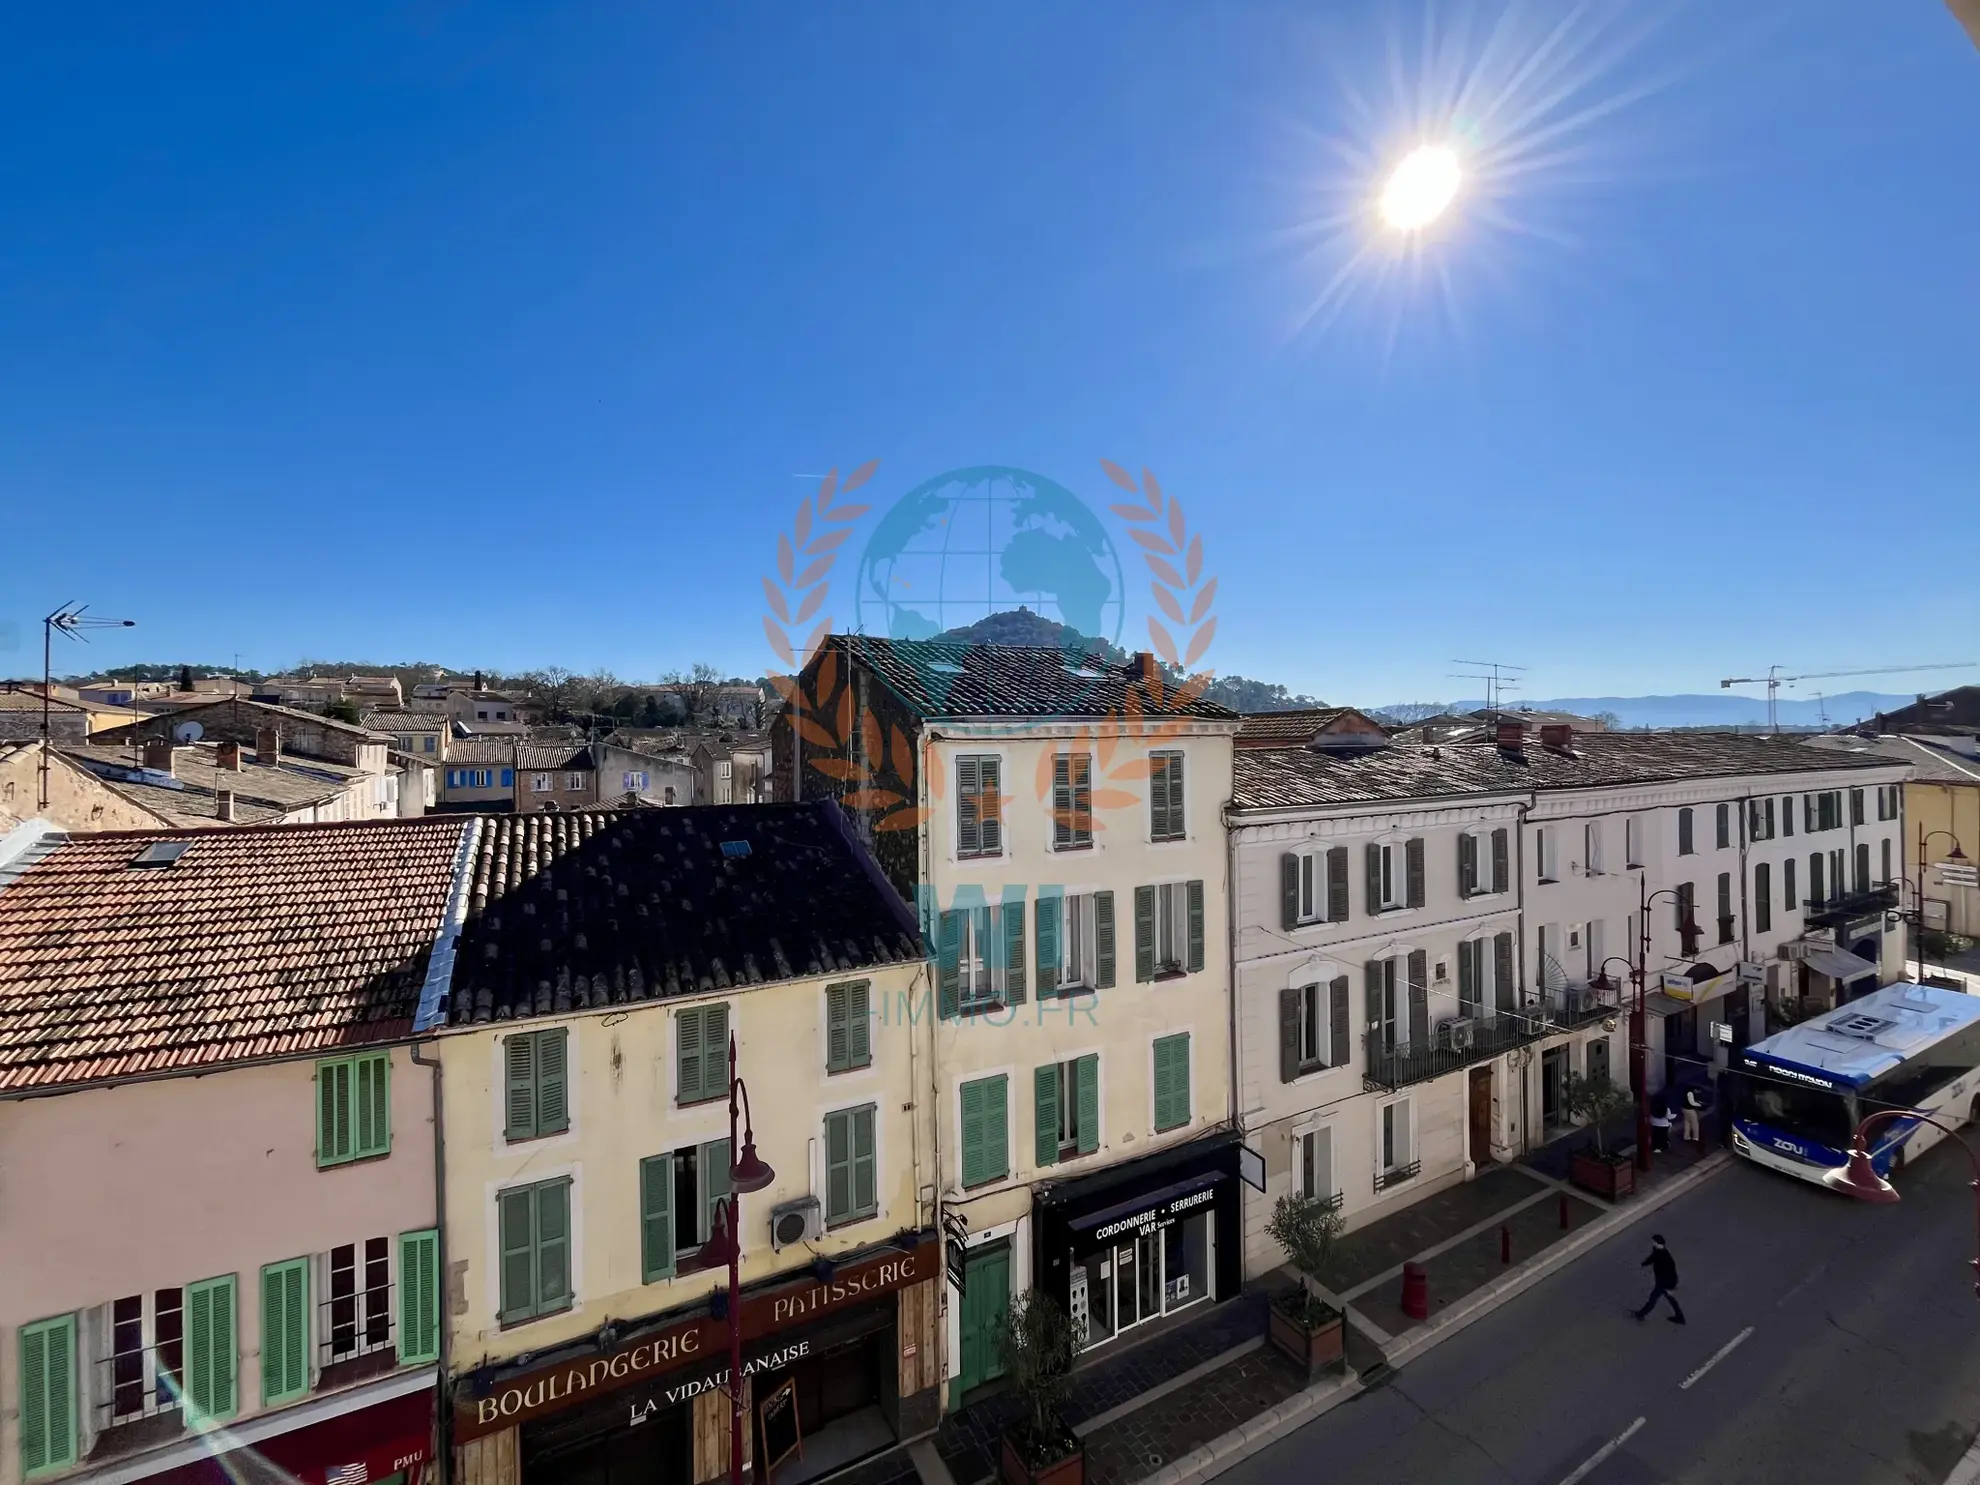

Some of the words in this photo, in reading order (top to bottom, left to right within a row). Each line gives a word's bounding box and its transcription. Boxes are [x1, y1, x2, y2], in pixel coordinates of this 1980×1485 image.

[1096, 1209, 1157, 1240] CORDONNERIE
[1170, 1188, 1215, 1213] SERRURERIE
[1139, 1222, 1157, 1237] VAR
[477, 1328, 701, 1426] BOULANGERIE
[773, 1255, 917, 1323] PATISSERIE
[630, 1398, 658, 1421] LA
[665, 1341, 810, 1406] VIDAUANAISE
[393, 1449, 424, 1471] PMU
